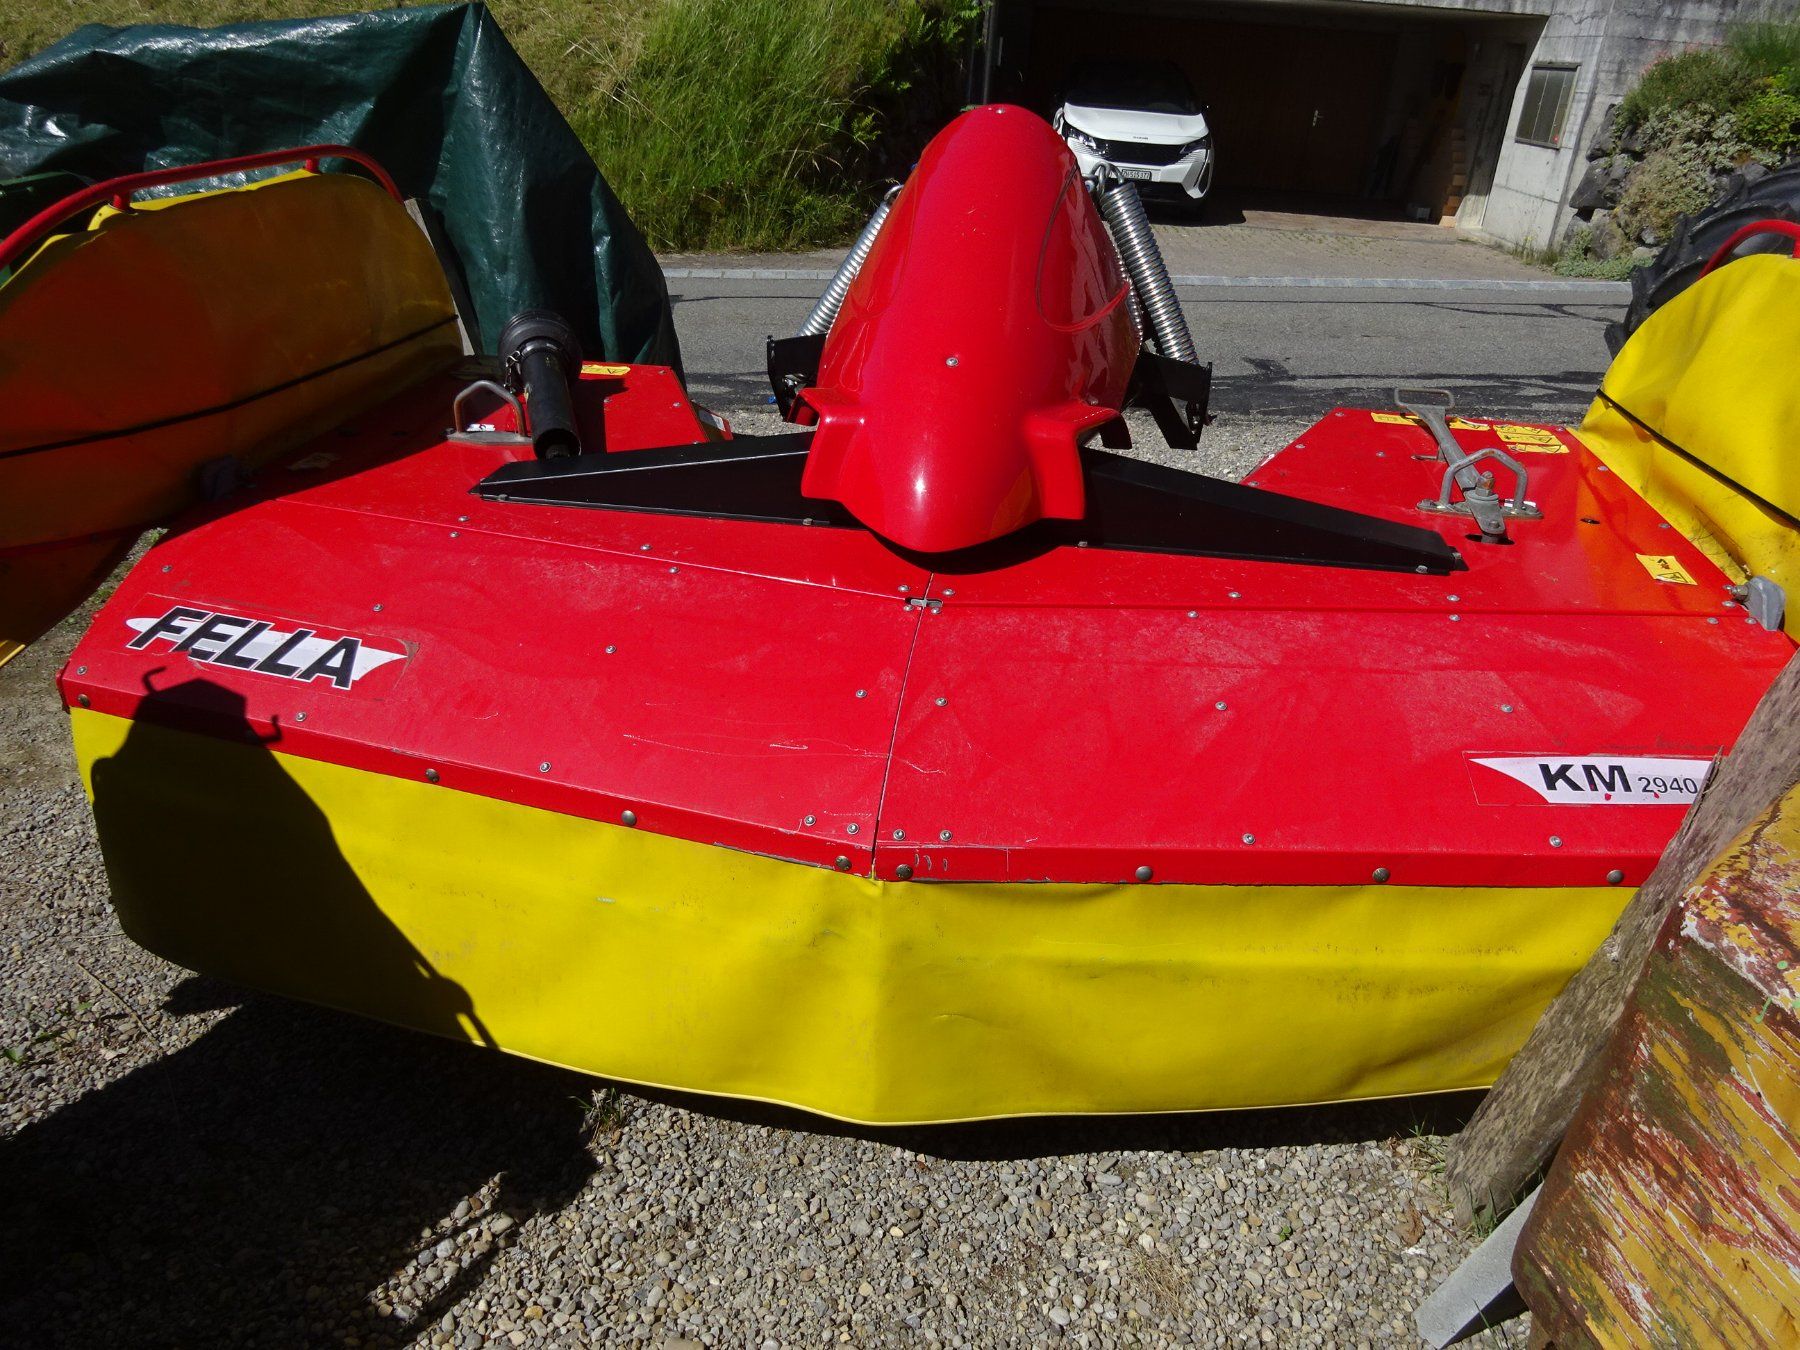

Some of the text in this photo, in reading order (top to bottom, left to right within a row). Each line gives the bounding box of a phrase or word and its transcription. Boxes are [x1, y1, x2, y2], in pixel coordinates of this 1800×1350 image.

[126, 605, 361, 690] FELLA
[1538, 763, 1698, 794] KM 2940
